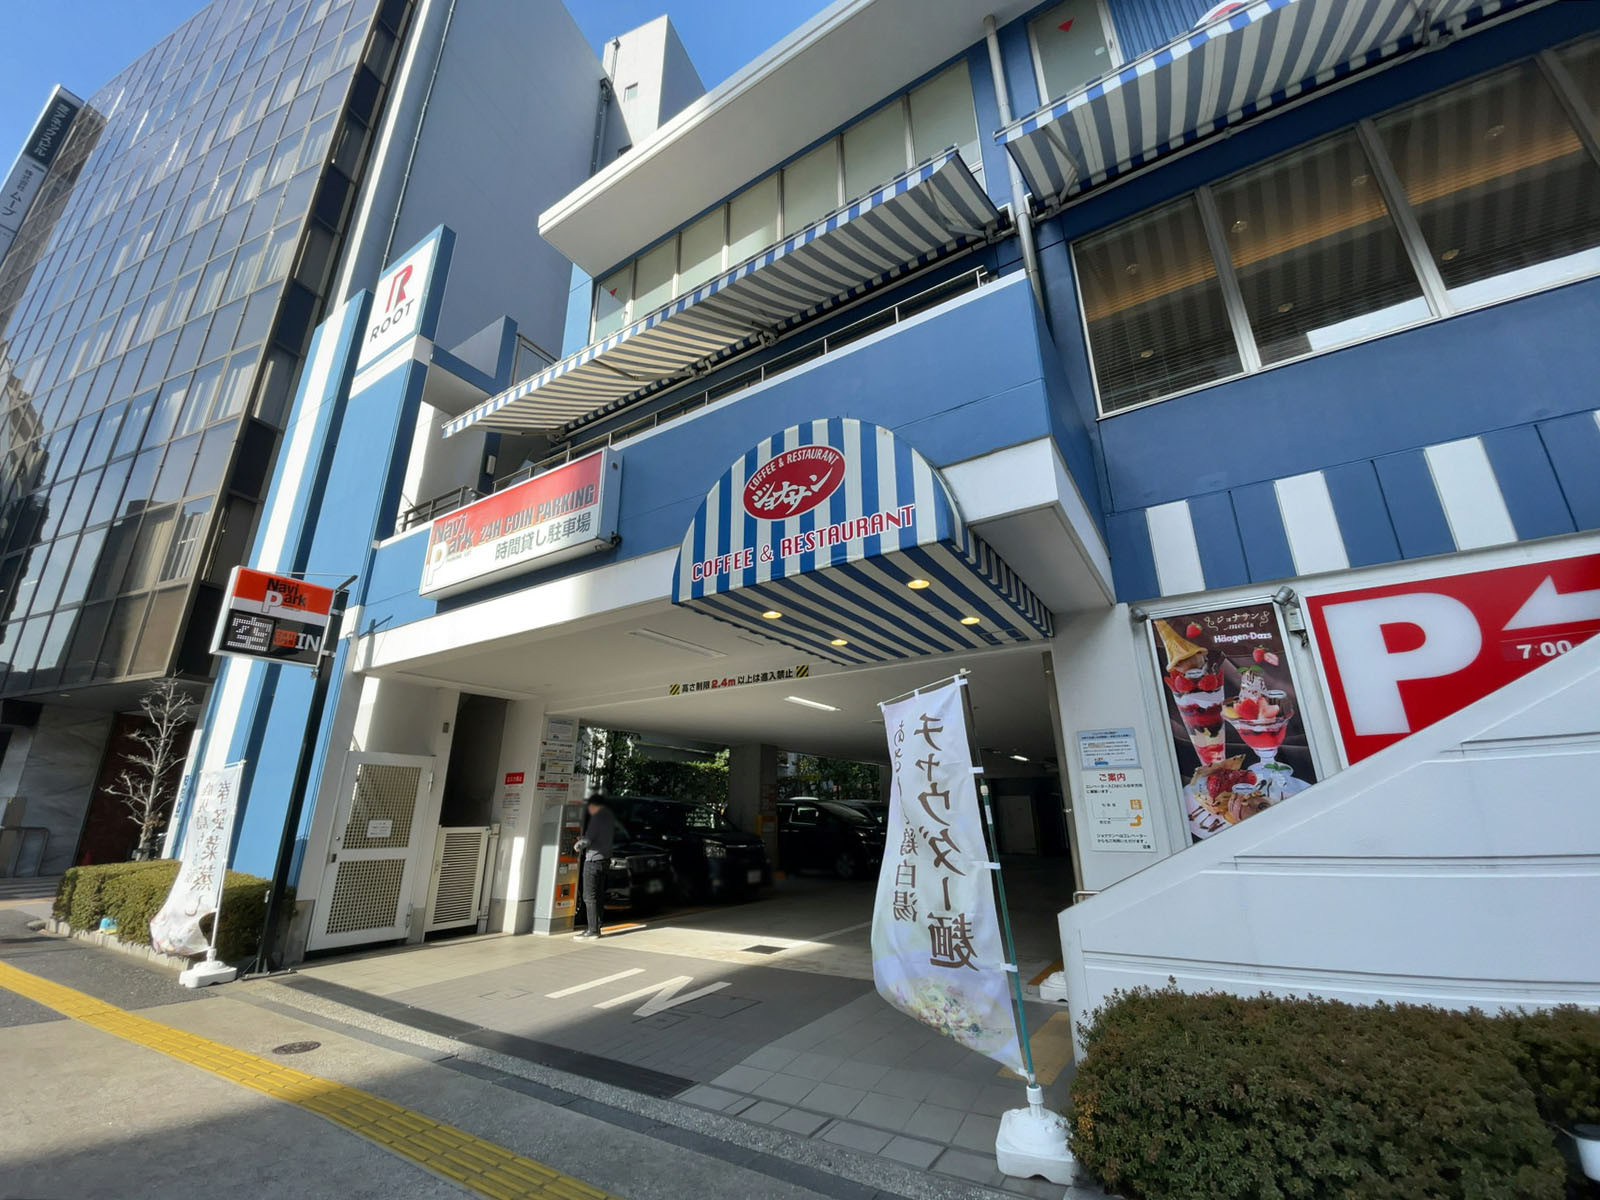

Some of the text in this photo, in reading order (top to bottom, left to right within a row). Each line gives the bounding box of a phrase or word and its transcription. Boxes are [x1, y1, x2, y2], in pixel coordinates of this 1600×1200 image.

[370, 298, 415, 343] ROOT
[749, 447, 840, 491] COFFEE & RESTAURANT
[752, 467, 834, 515] ジョナサン
[479, 484, 595, 543] 24H COIN PARKING
[494, 511, 592, 561] 時間貸し駐車場
[691, 503, 916, 582] COFFEE & RESTAURANT
[267, 577, 300, 595] Navi
[261, 590, 307, 614] Park
[1216, 612, 1260, 624] ジョナサン
[1225, 621, 1254, 630] meets
[295, 632, 321, 652] IN
[1213, 632, 1273, 644] Häagen-Dazs
[1321, 591, 1483, 737] P
[711, 677, 736, 688] 2.4m
[1098, 772, 1127, 782] ご案内
